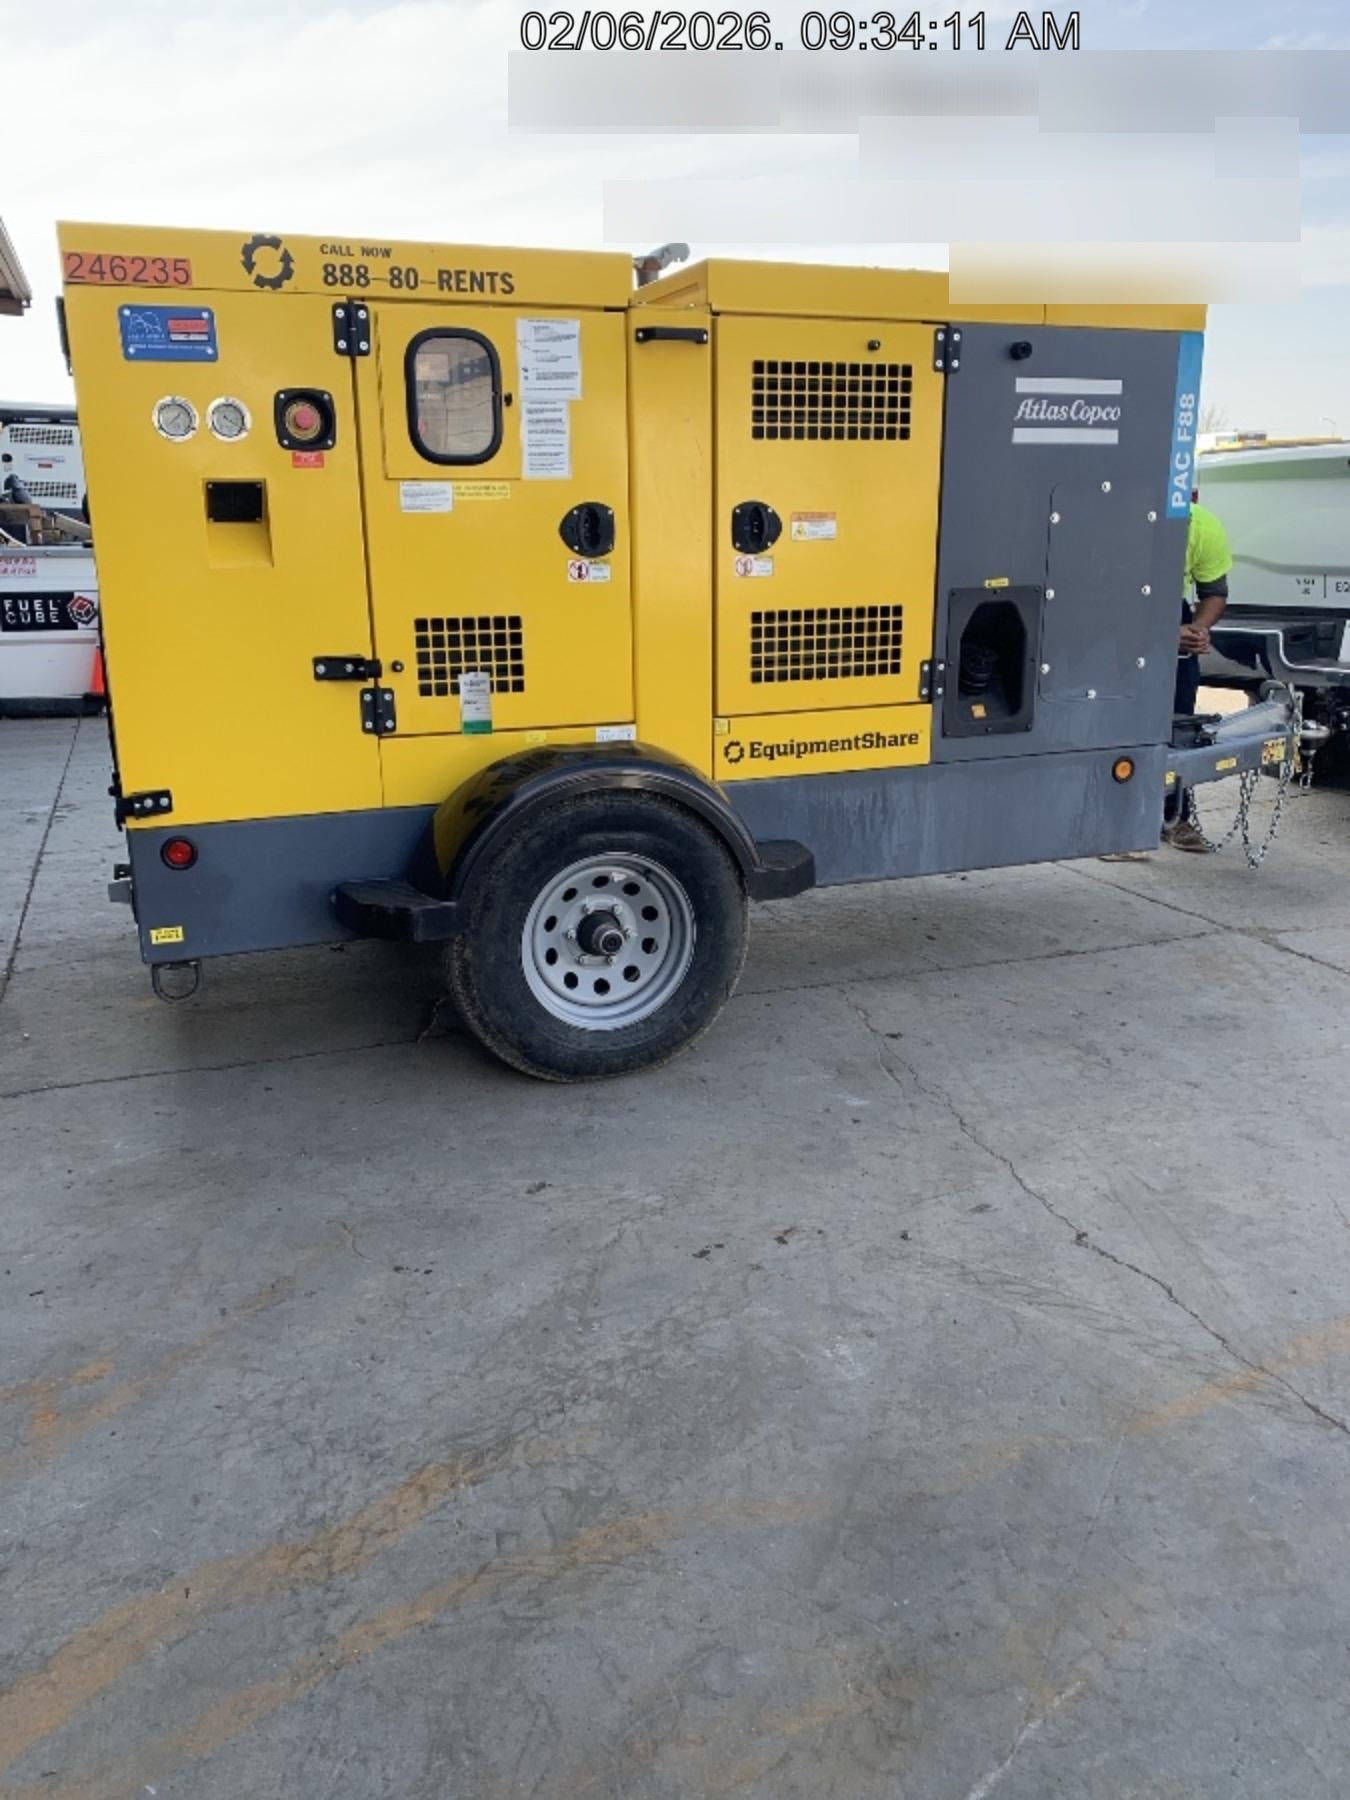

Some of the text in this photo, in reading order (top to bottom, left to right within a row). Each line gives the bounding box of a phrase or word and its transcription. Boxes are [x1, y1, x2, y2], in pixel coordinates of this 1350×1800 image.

[320, 244, 392, 259] CALL NOW
[66, 252, 190, 285] 246235
[1172, 393, 1195, 508] PAC F88
[3, 600, 59, 611] FUEL
[6, 611, 60, 624] CUBE
[749, 731, 919, 761] EquipmentShare
